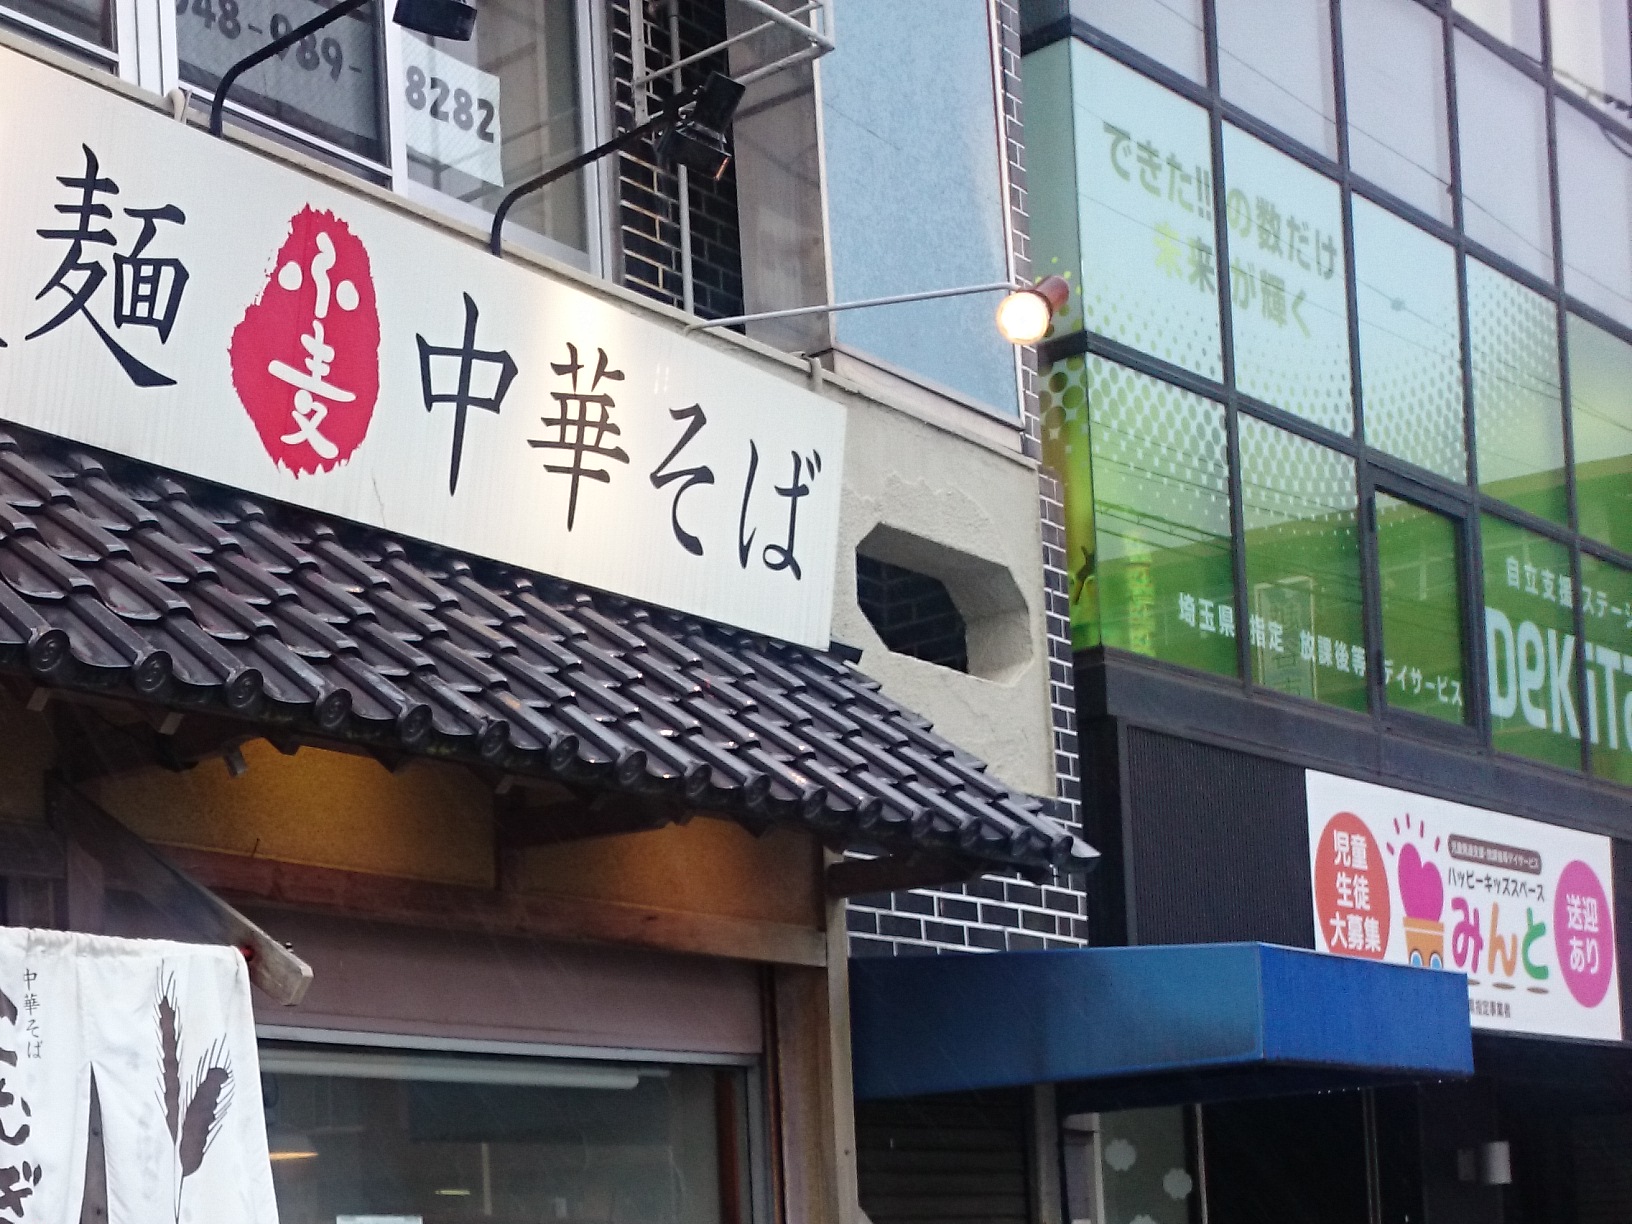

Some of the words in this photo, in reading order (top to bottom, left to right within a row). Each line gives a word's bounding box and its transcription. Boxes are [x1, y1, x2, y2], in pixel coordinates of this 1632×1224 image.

[405, 65, 494, 144] 8282
[414, 292, 823, 582] 中華そば
[1333, 829, 1368, 870] 児童
[1335, 871, 1371, 911] 生徒
[1329, 912, 1381, 952] 大募集
[1566, 894, 1599, 933] 送迎
[1450, 897, 1549, 980] みんと
[1569, 936, 1600, 975] あり
[22, 968, 42, 1060] 中華そば
